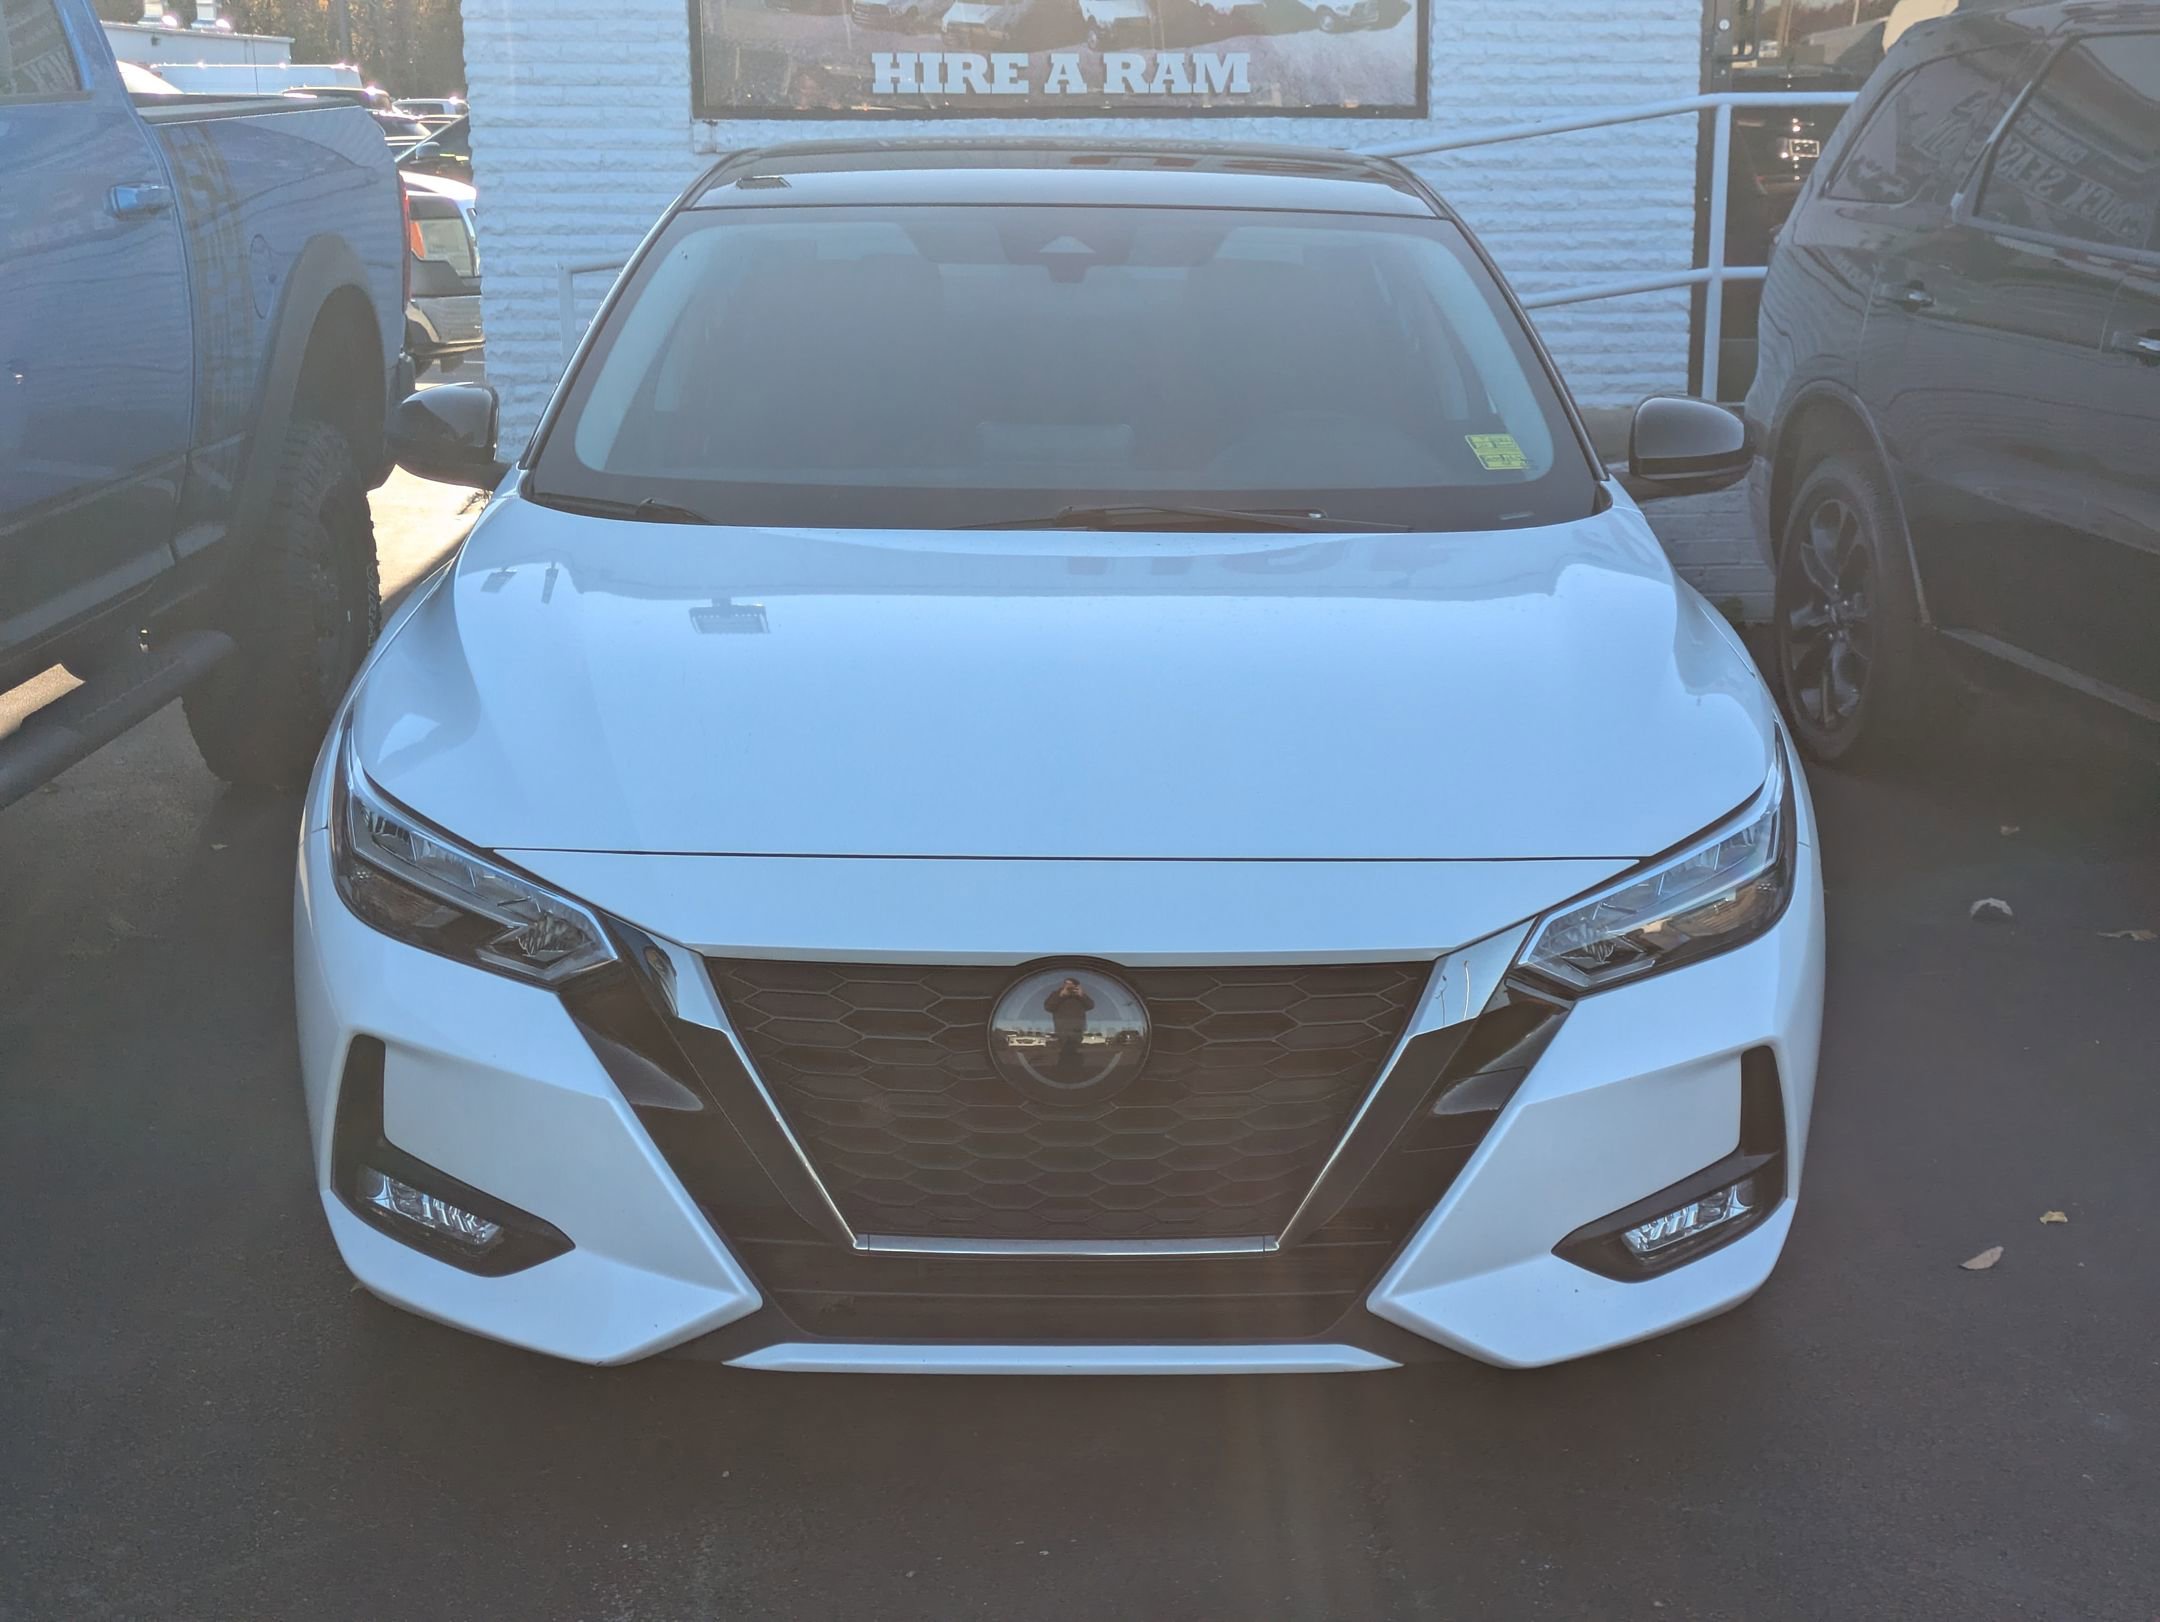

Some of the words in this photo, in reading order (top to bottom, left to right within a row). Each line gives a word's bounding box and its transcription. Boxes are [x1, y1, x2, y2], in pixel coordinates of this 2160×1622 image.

[871, 52, 1029, 94] HIRE
[1044, 52, 1087, 94] A
[1103, 52, 1251, 94] RAM
